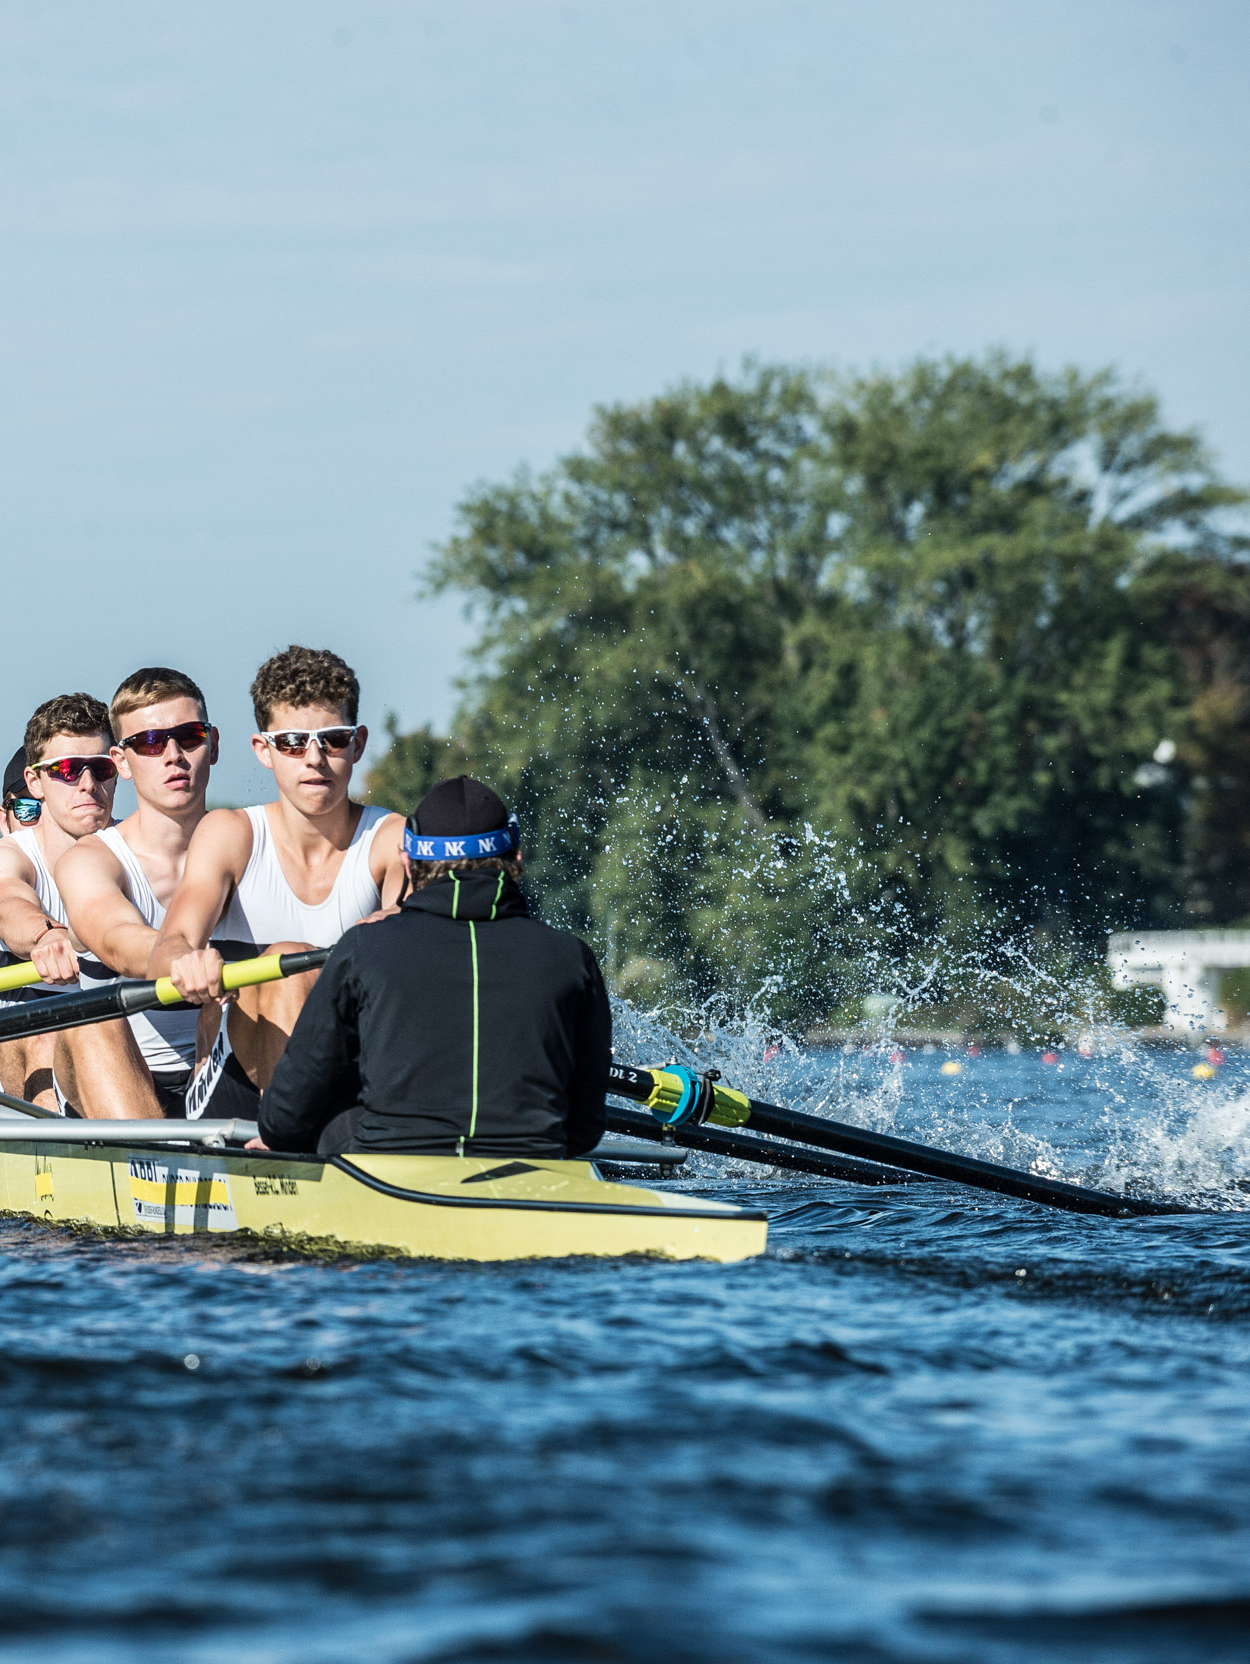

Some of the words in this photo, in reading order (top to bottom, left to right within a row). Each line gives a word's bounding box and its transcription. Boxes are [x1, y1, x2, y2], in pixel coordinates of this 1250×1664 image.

[416, 840, 435, 857] NK
[444, 841, 466, 857] NK
[477, 836, 498, 854] NK
[628, 1071, 638, 1083] 2
